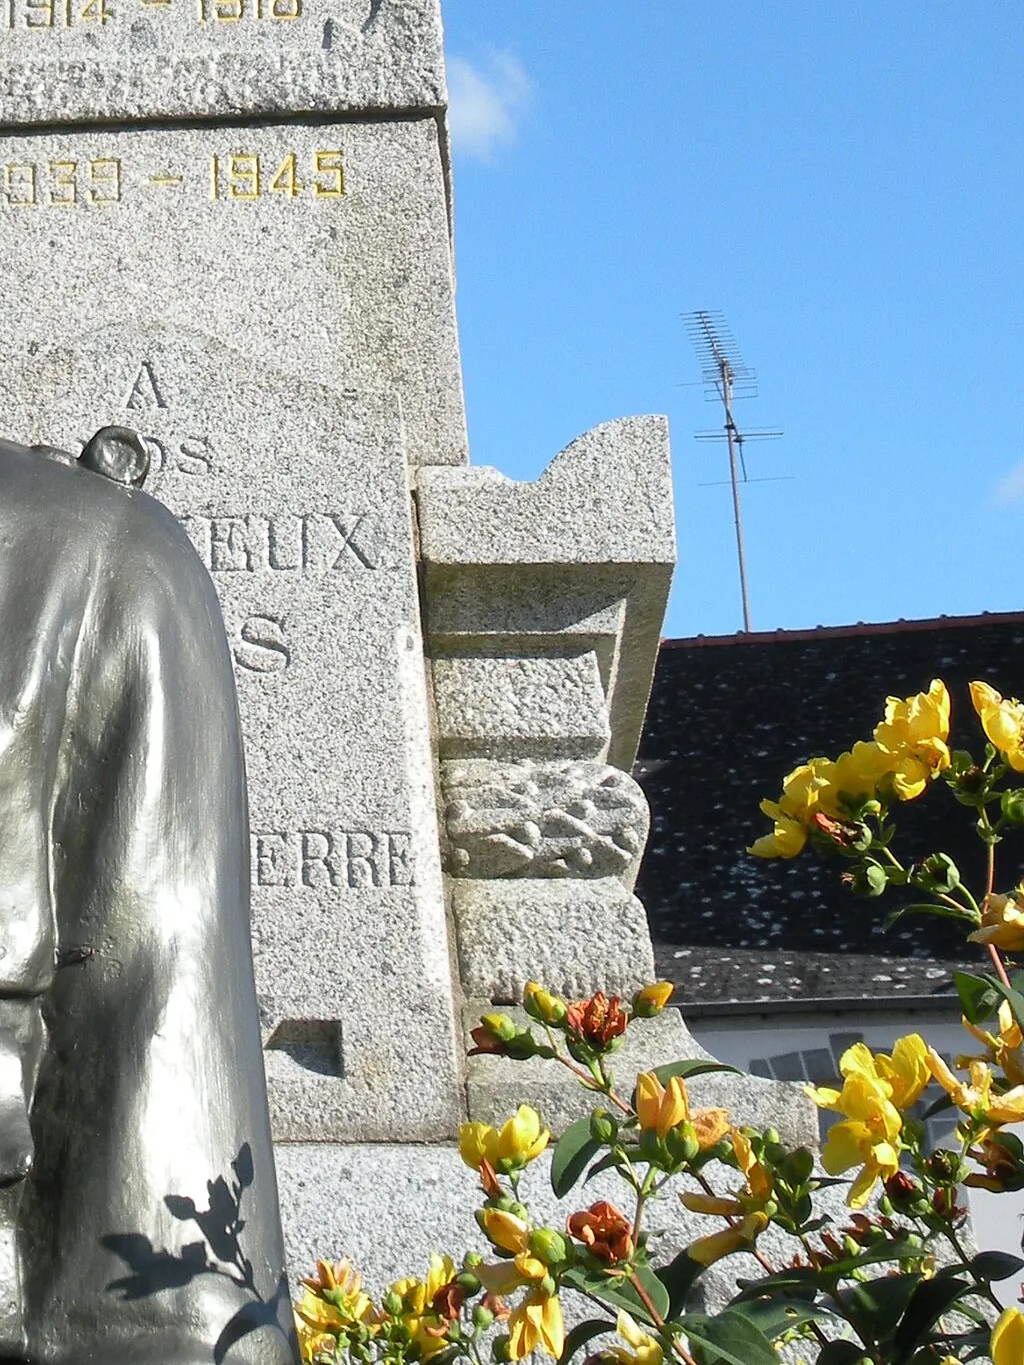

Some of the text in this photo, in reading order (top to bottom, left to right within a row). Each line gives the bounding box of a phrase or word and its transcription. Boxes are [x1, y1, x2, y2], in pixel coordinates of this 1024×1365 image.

[209, 150, 346, 202] 1945
[125, 360, 169, 410] A
[179, 512, 378, 572] EUX
[251, 829, 417, 888] ERRE
